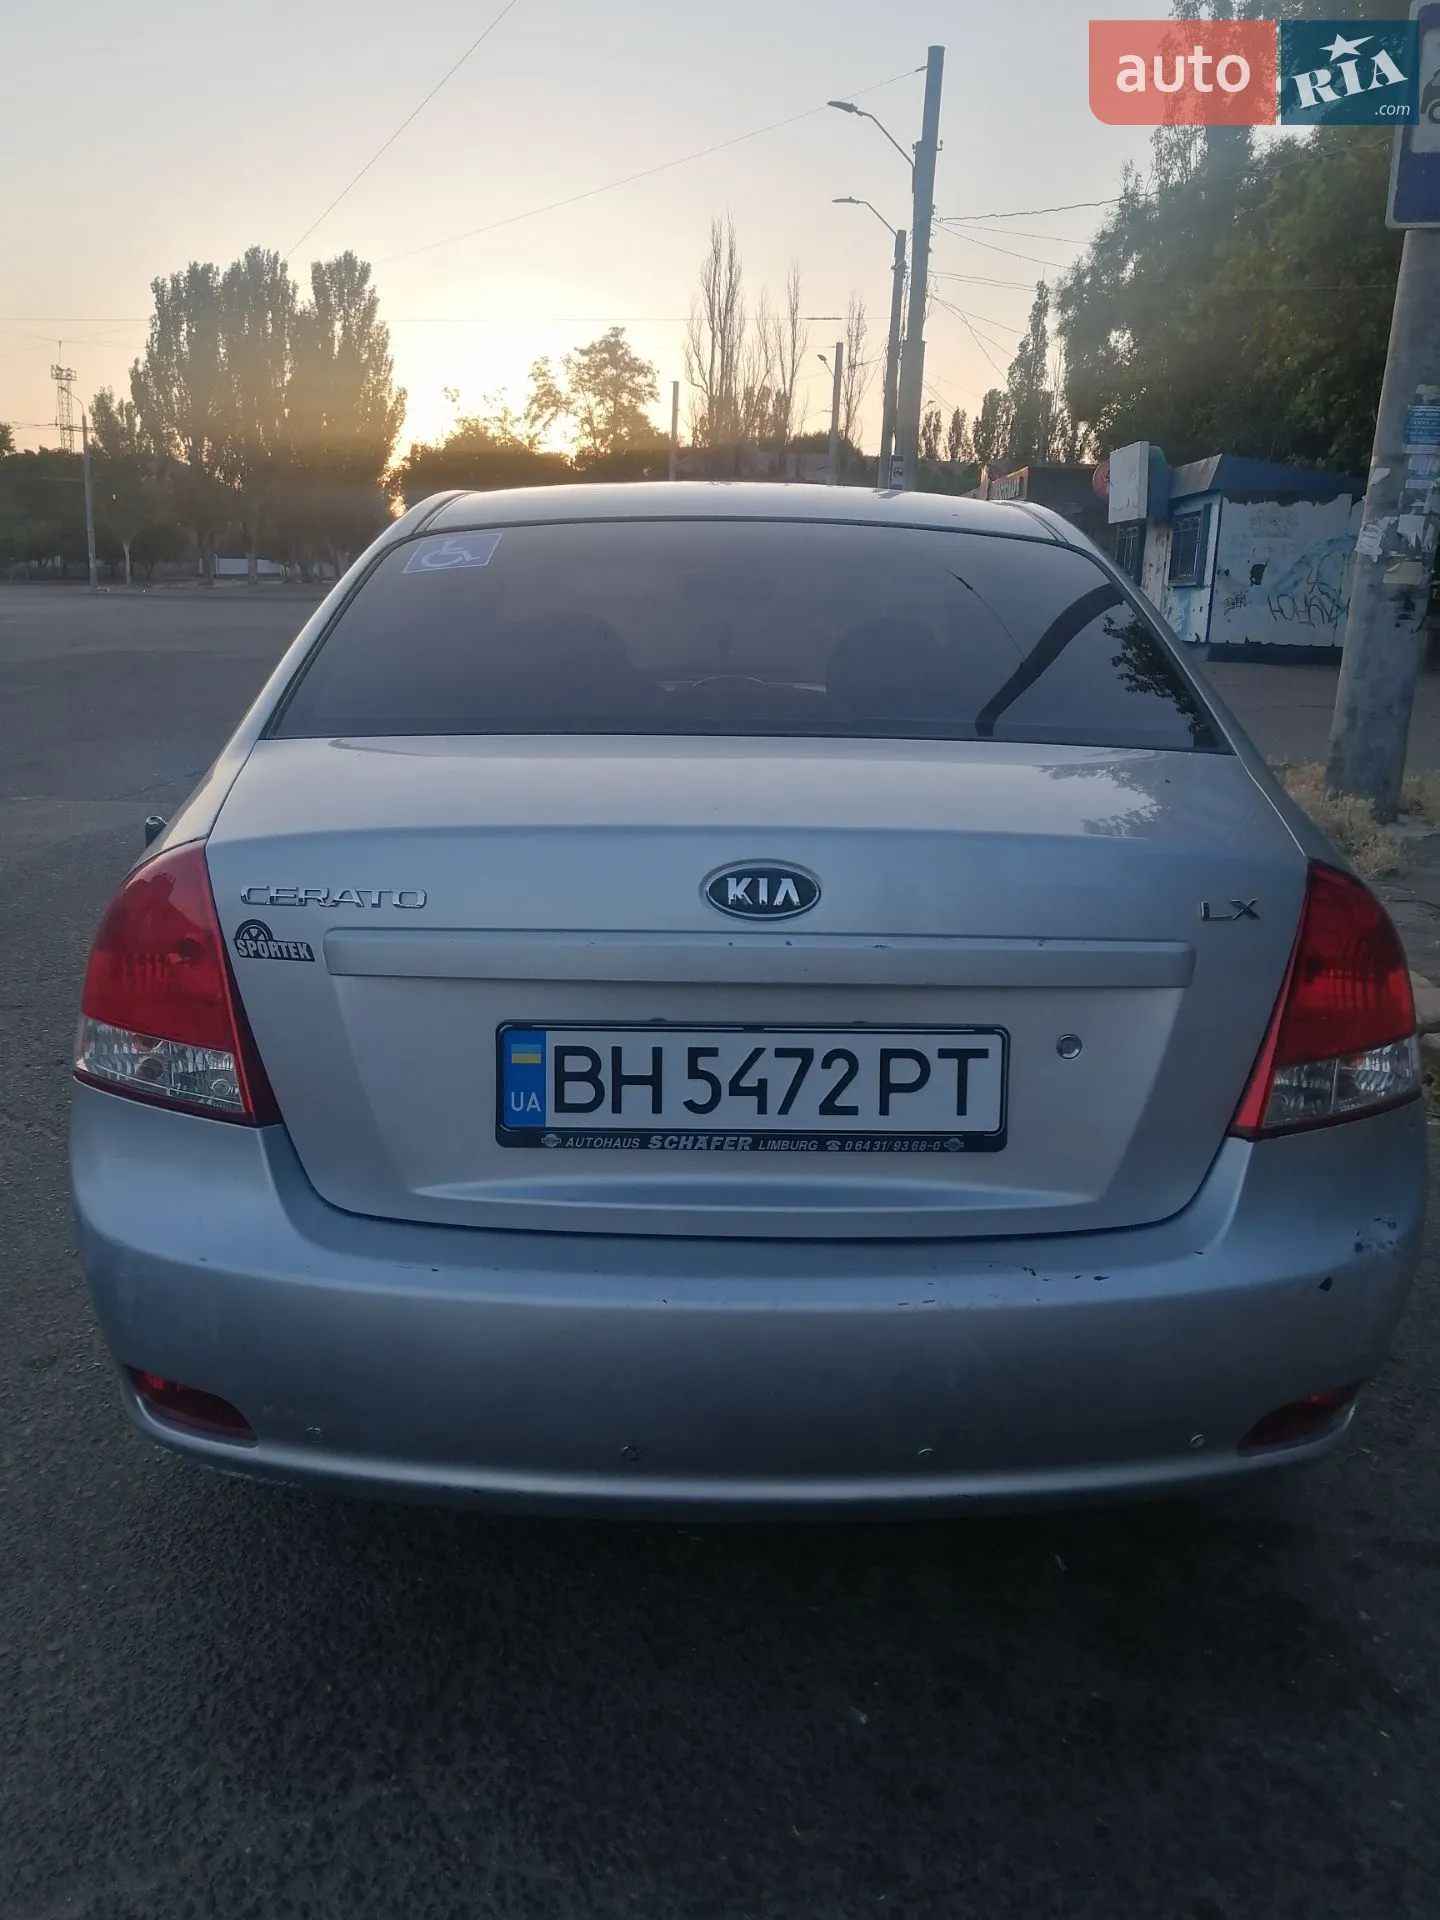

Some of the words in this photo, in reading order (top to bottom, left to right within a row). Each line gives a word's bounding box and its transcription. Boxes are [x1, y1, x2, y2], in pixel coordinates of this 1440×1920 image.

[240, 886, 428, 909] CERATO
[726, 877, 801, 906] KIA
[1201, 898, 1260, 921] LX
[235, 938, 314, 961] SPORTEK
[682, 1046, 860, 1117] 5472
[510, 1091, 542, 1113] UA
[565, 1136, 641, 1149] AUTOHAUS
[647, 1134, 752, 1151] SCHÄFER
[758, 1139, 819, 1151] LIMBURG
